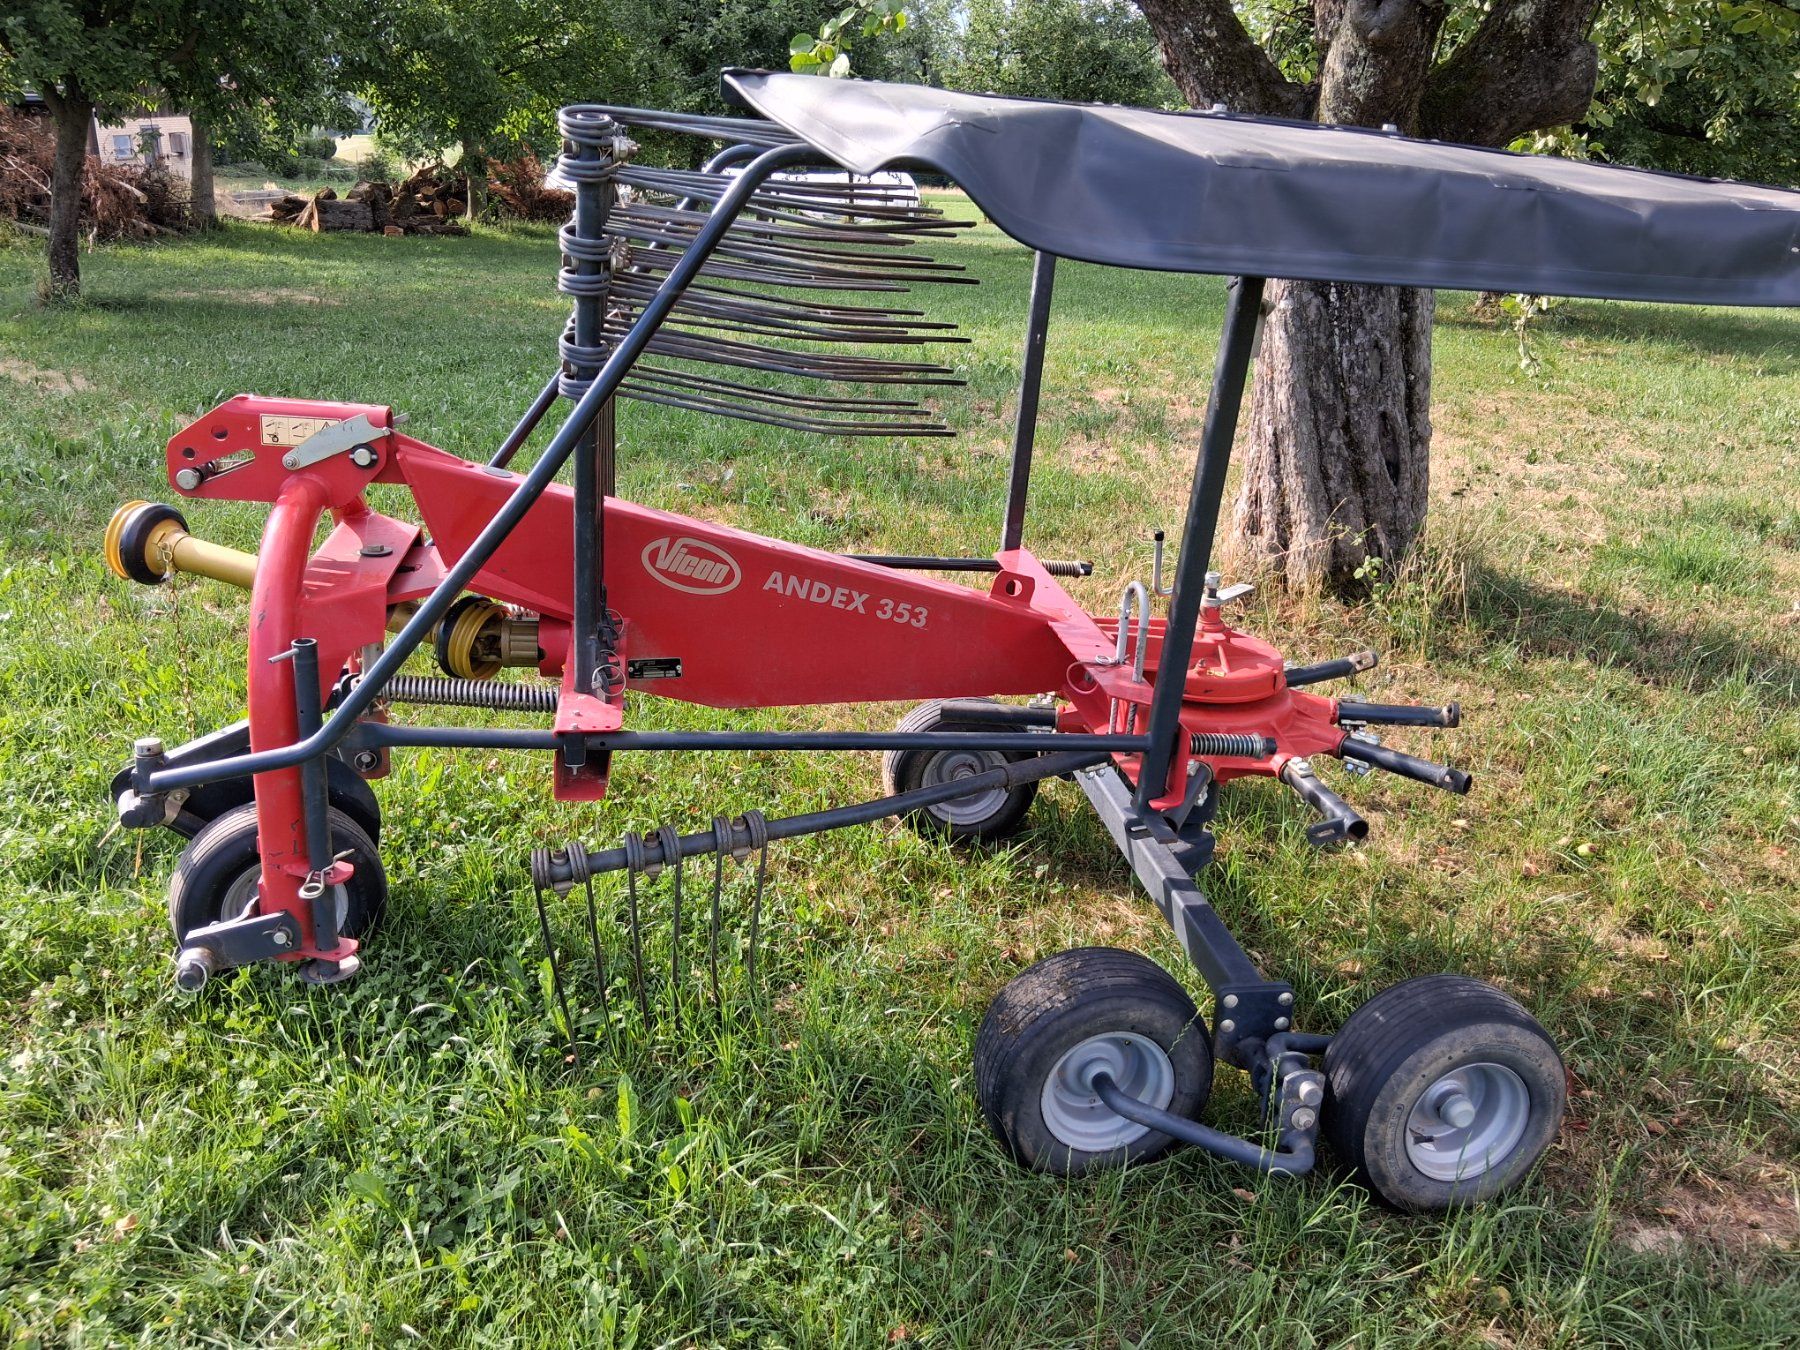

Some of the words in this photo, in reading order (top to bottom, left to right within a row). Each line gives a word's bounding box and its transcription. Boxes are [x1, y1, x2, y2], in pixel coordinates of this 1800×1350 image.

[655, 537, 730, 584] Vicon
[762, 570, 869, 614] ANDEX
[875, 598, 928, 628] 353
